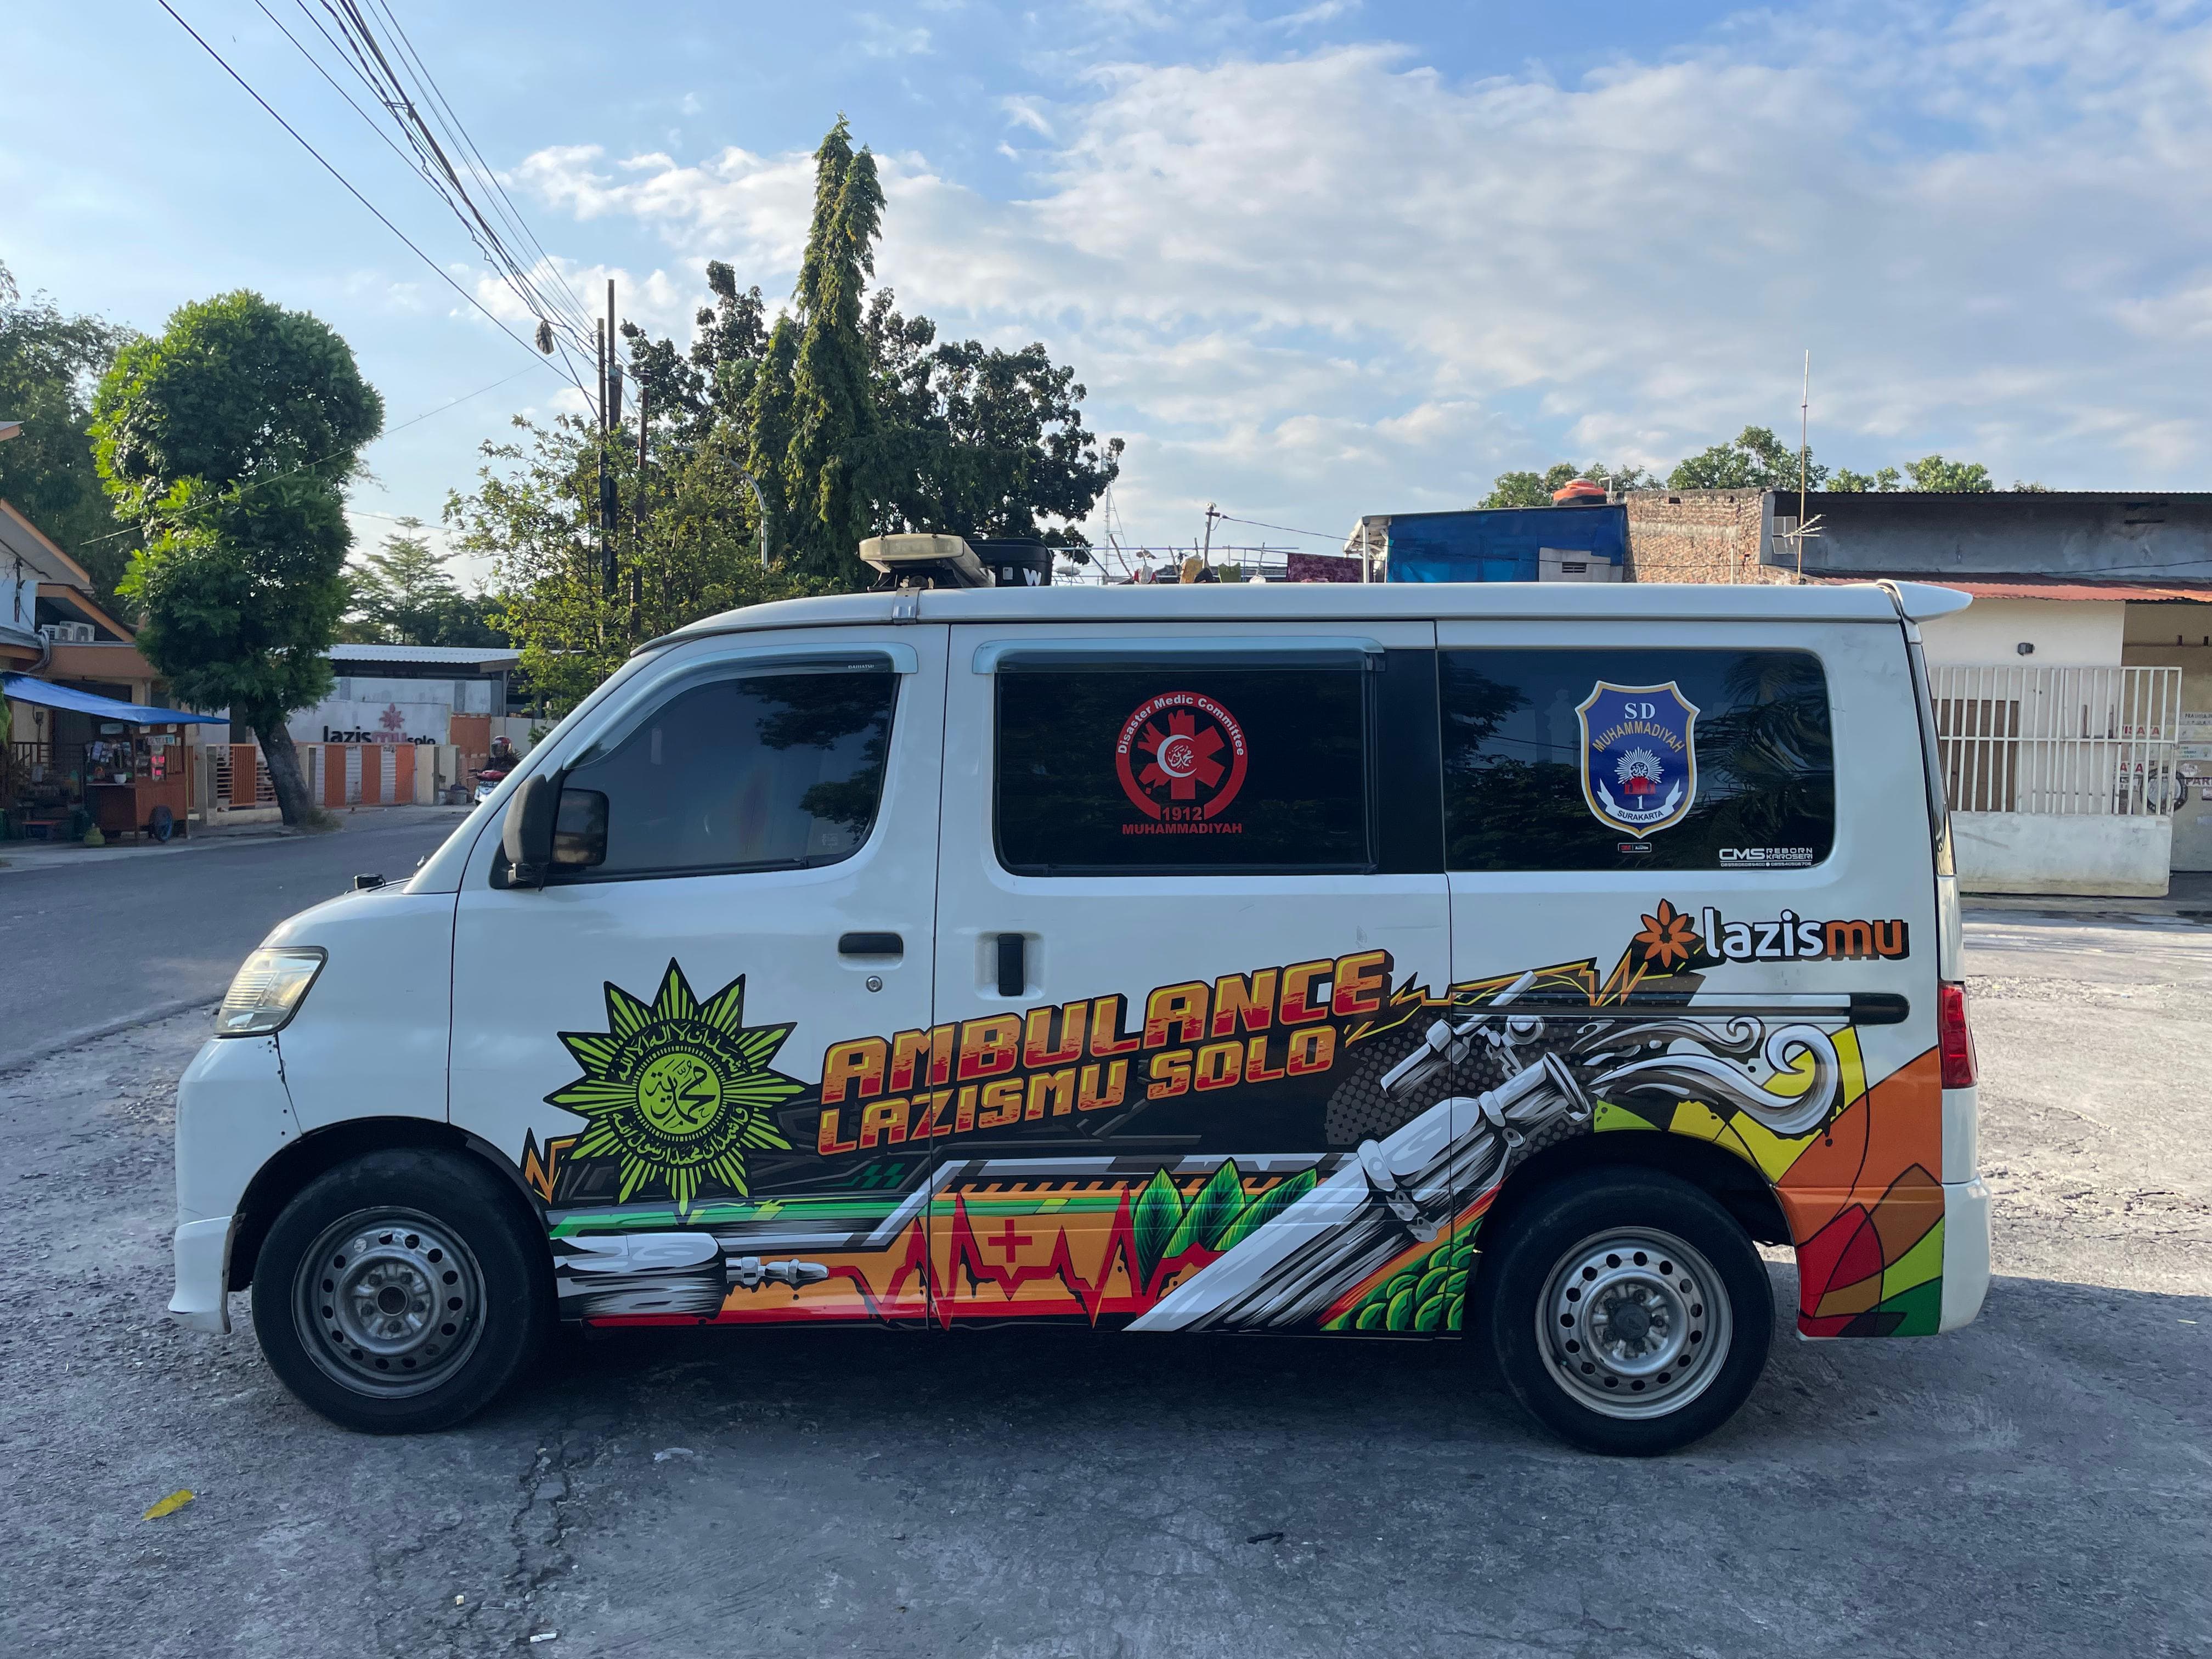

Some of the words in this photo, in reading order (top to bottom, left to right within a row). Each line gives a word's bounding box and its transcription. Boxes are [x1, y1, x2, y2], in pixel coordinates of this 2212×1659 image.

[1624, 702, 1656, 719] SD
[1118, 706, 1152, 754] Disaster
[1153, 695, 1194, 709] Medic
[1198, 697, 1244, 756] Committee
[1592, 721, 1685, 753] MUHAMMADIYAH
[1637, 795, 1644, 810] 1
[1162, 806, 1203, 822] 1912
[1617, 810, 1664, 821] SURAKARTA
[1122, 823, 1242, 835] MUHAMMADIYAH
[1719, 848, 1765, 860] CMS
[1703, 906, 1906, 960] lazismu
[821, 950, 1391, 1105] AMBULANCE
[817, 1058, 1129, 1156] LAZISMU
[1147, 1026, 1337, 1101] SOLO
